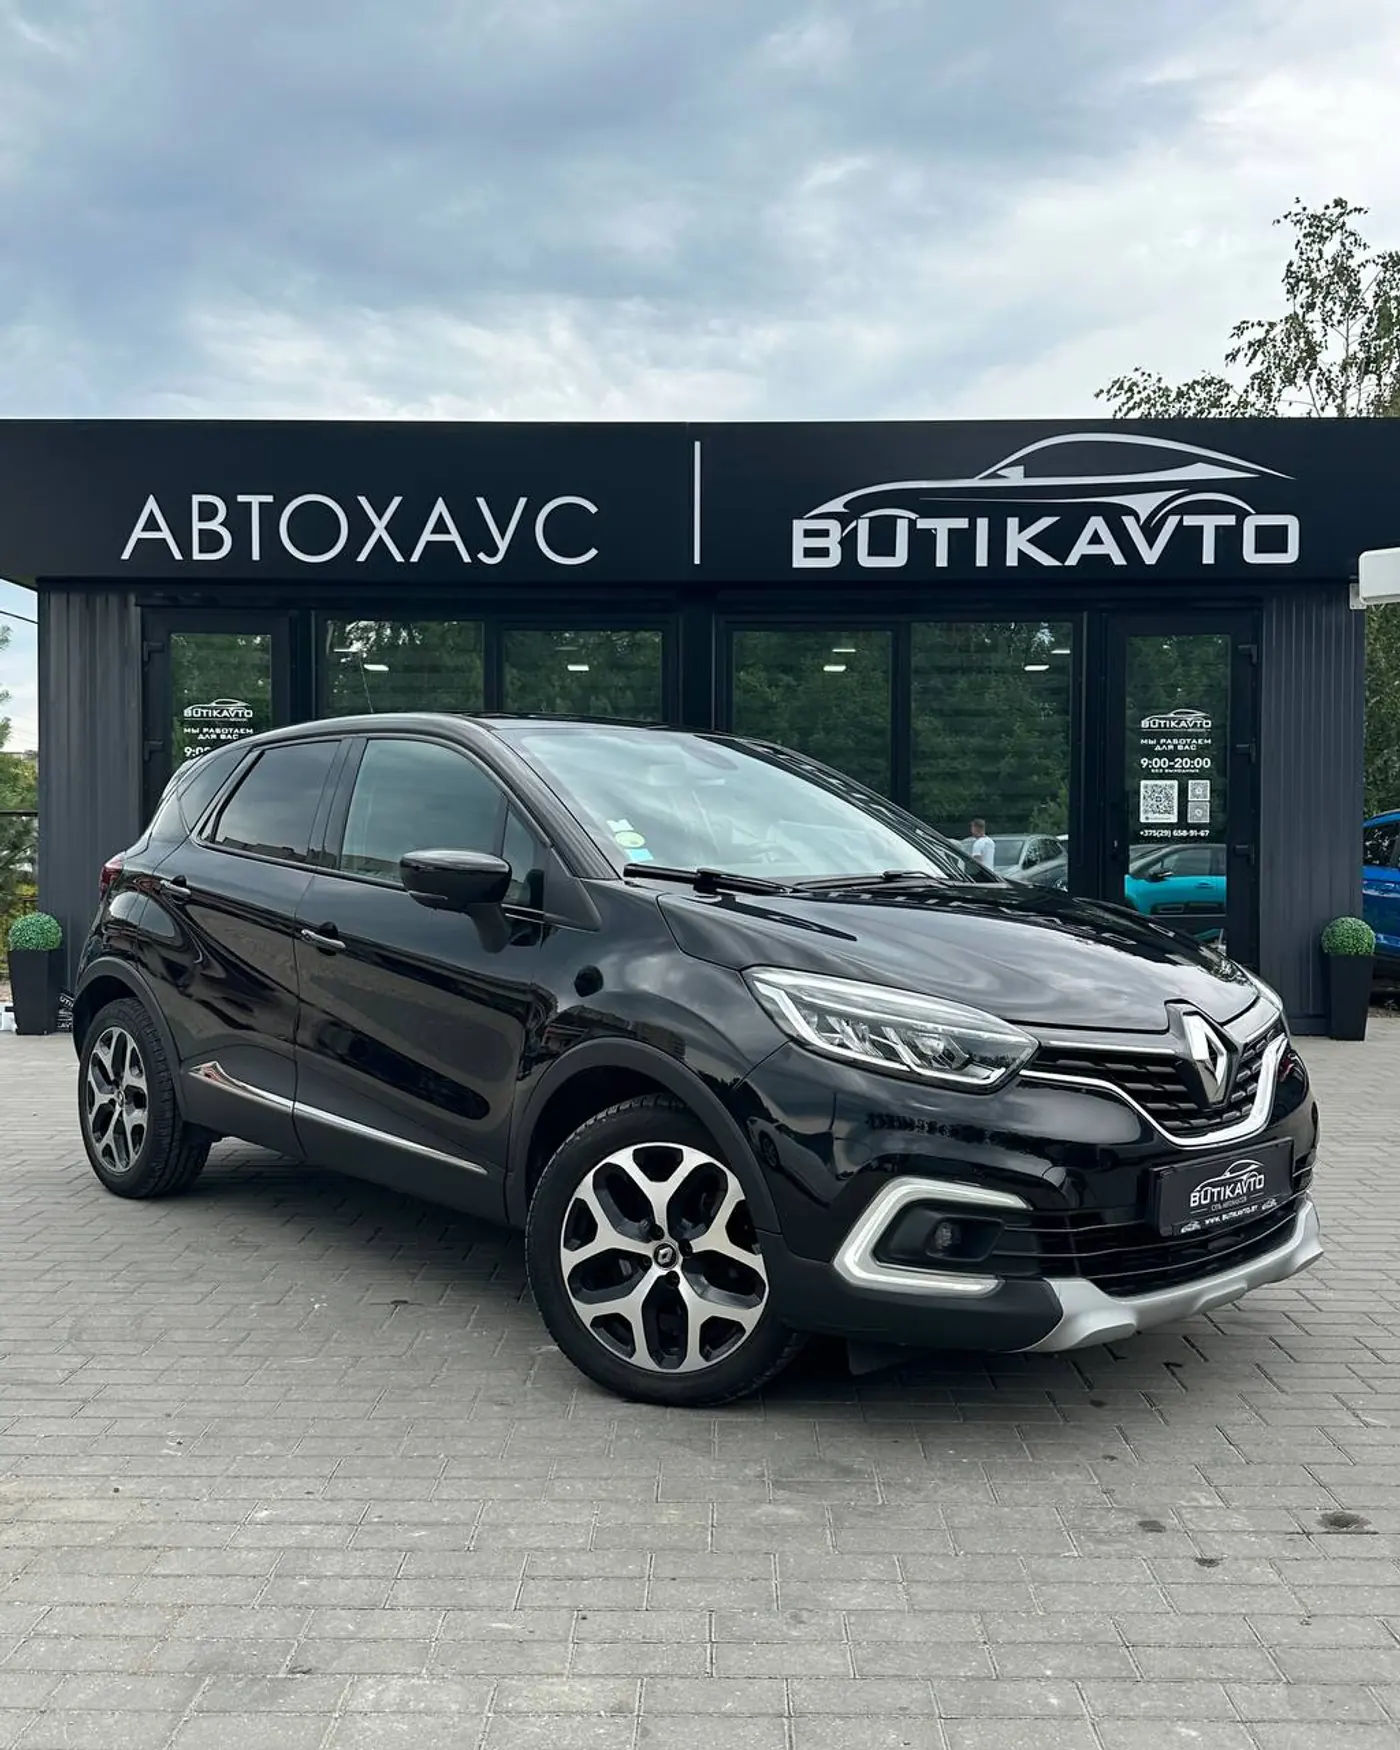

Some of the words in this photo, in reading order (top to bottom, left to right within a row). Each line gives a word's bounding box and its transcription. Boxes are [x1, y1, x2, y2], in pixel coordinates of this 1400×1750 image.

[121, 493, 600, 566] АВТОХАУС
[792, 513, 1300, 569] BUTIKAVTO
[183, 709, 253, 717] BUTIKAVTO
[1141, 719, 1211, 728] BUTIKAVTO
[1140, 757, 1211, 768] 9:00-20:00
[1191, 1176, 1265, 1207] BUTIKAVTO
